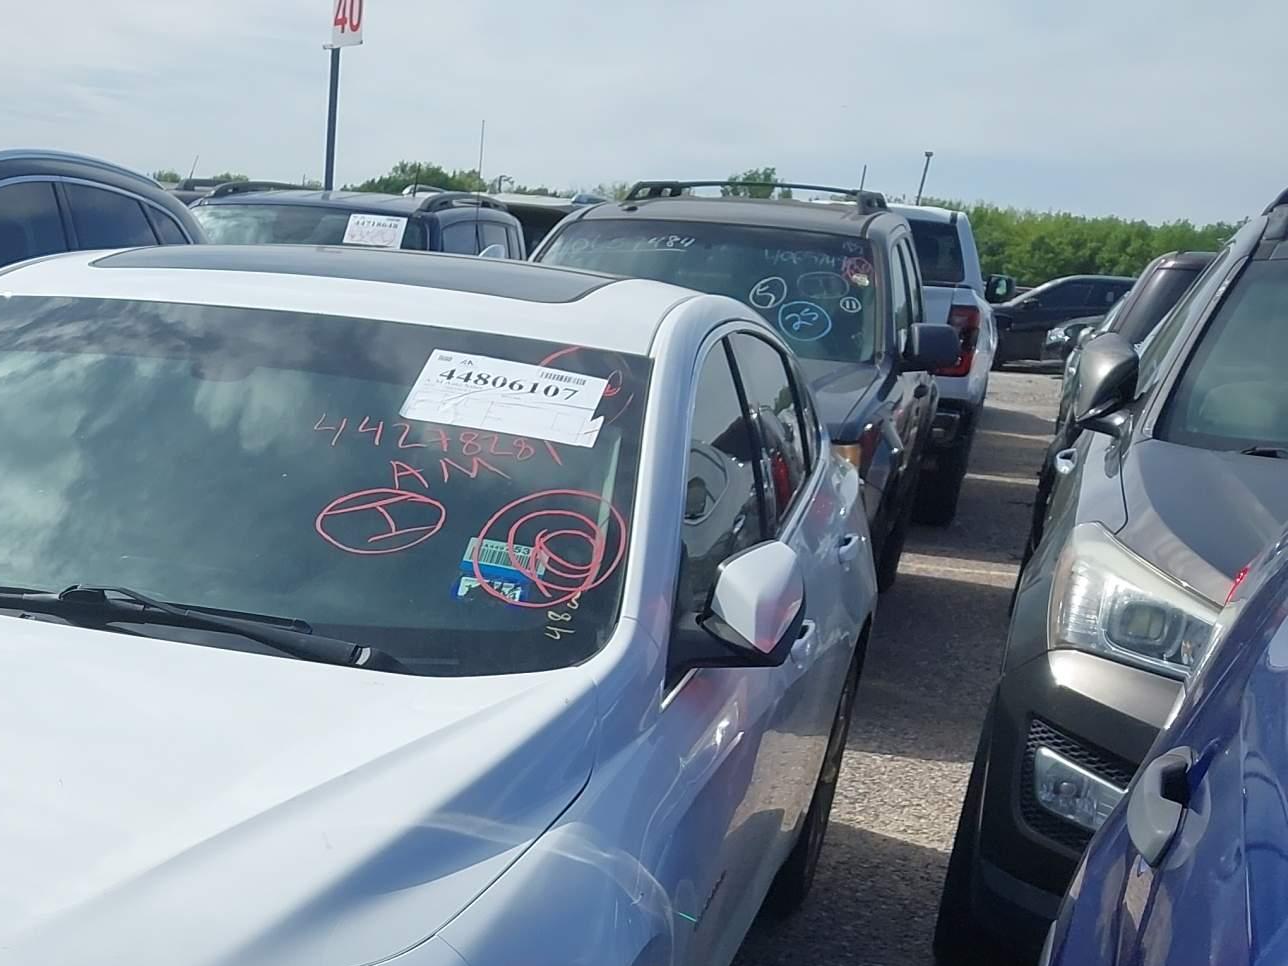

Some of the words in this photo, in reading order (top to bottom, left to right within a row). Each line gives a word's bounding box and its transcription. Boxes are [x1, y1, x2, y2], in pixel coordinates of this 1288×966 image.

[334, 0, 363, 33] 40
[756, 285, 776, 307] 5
[784, 307, 819, 331] 25
[439, 368, 579, 401] 44806107
